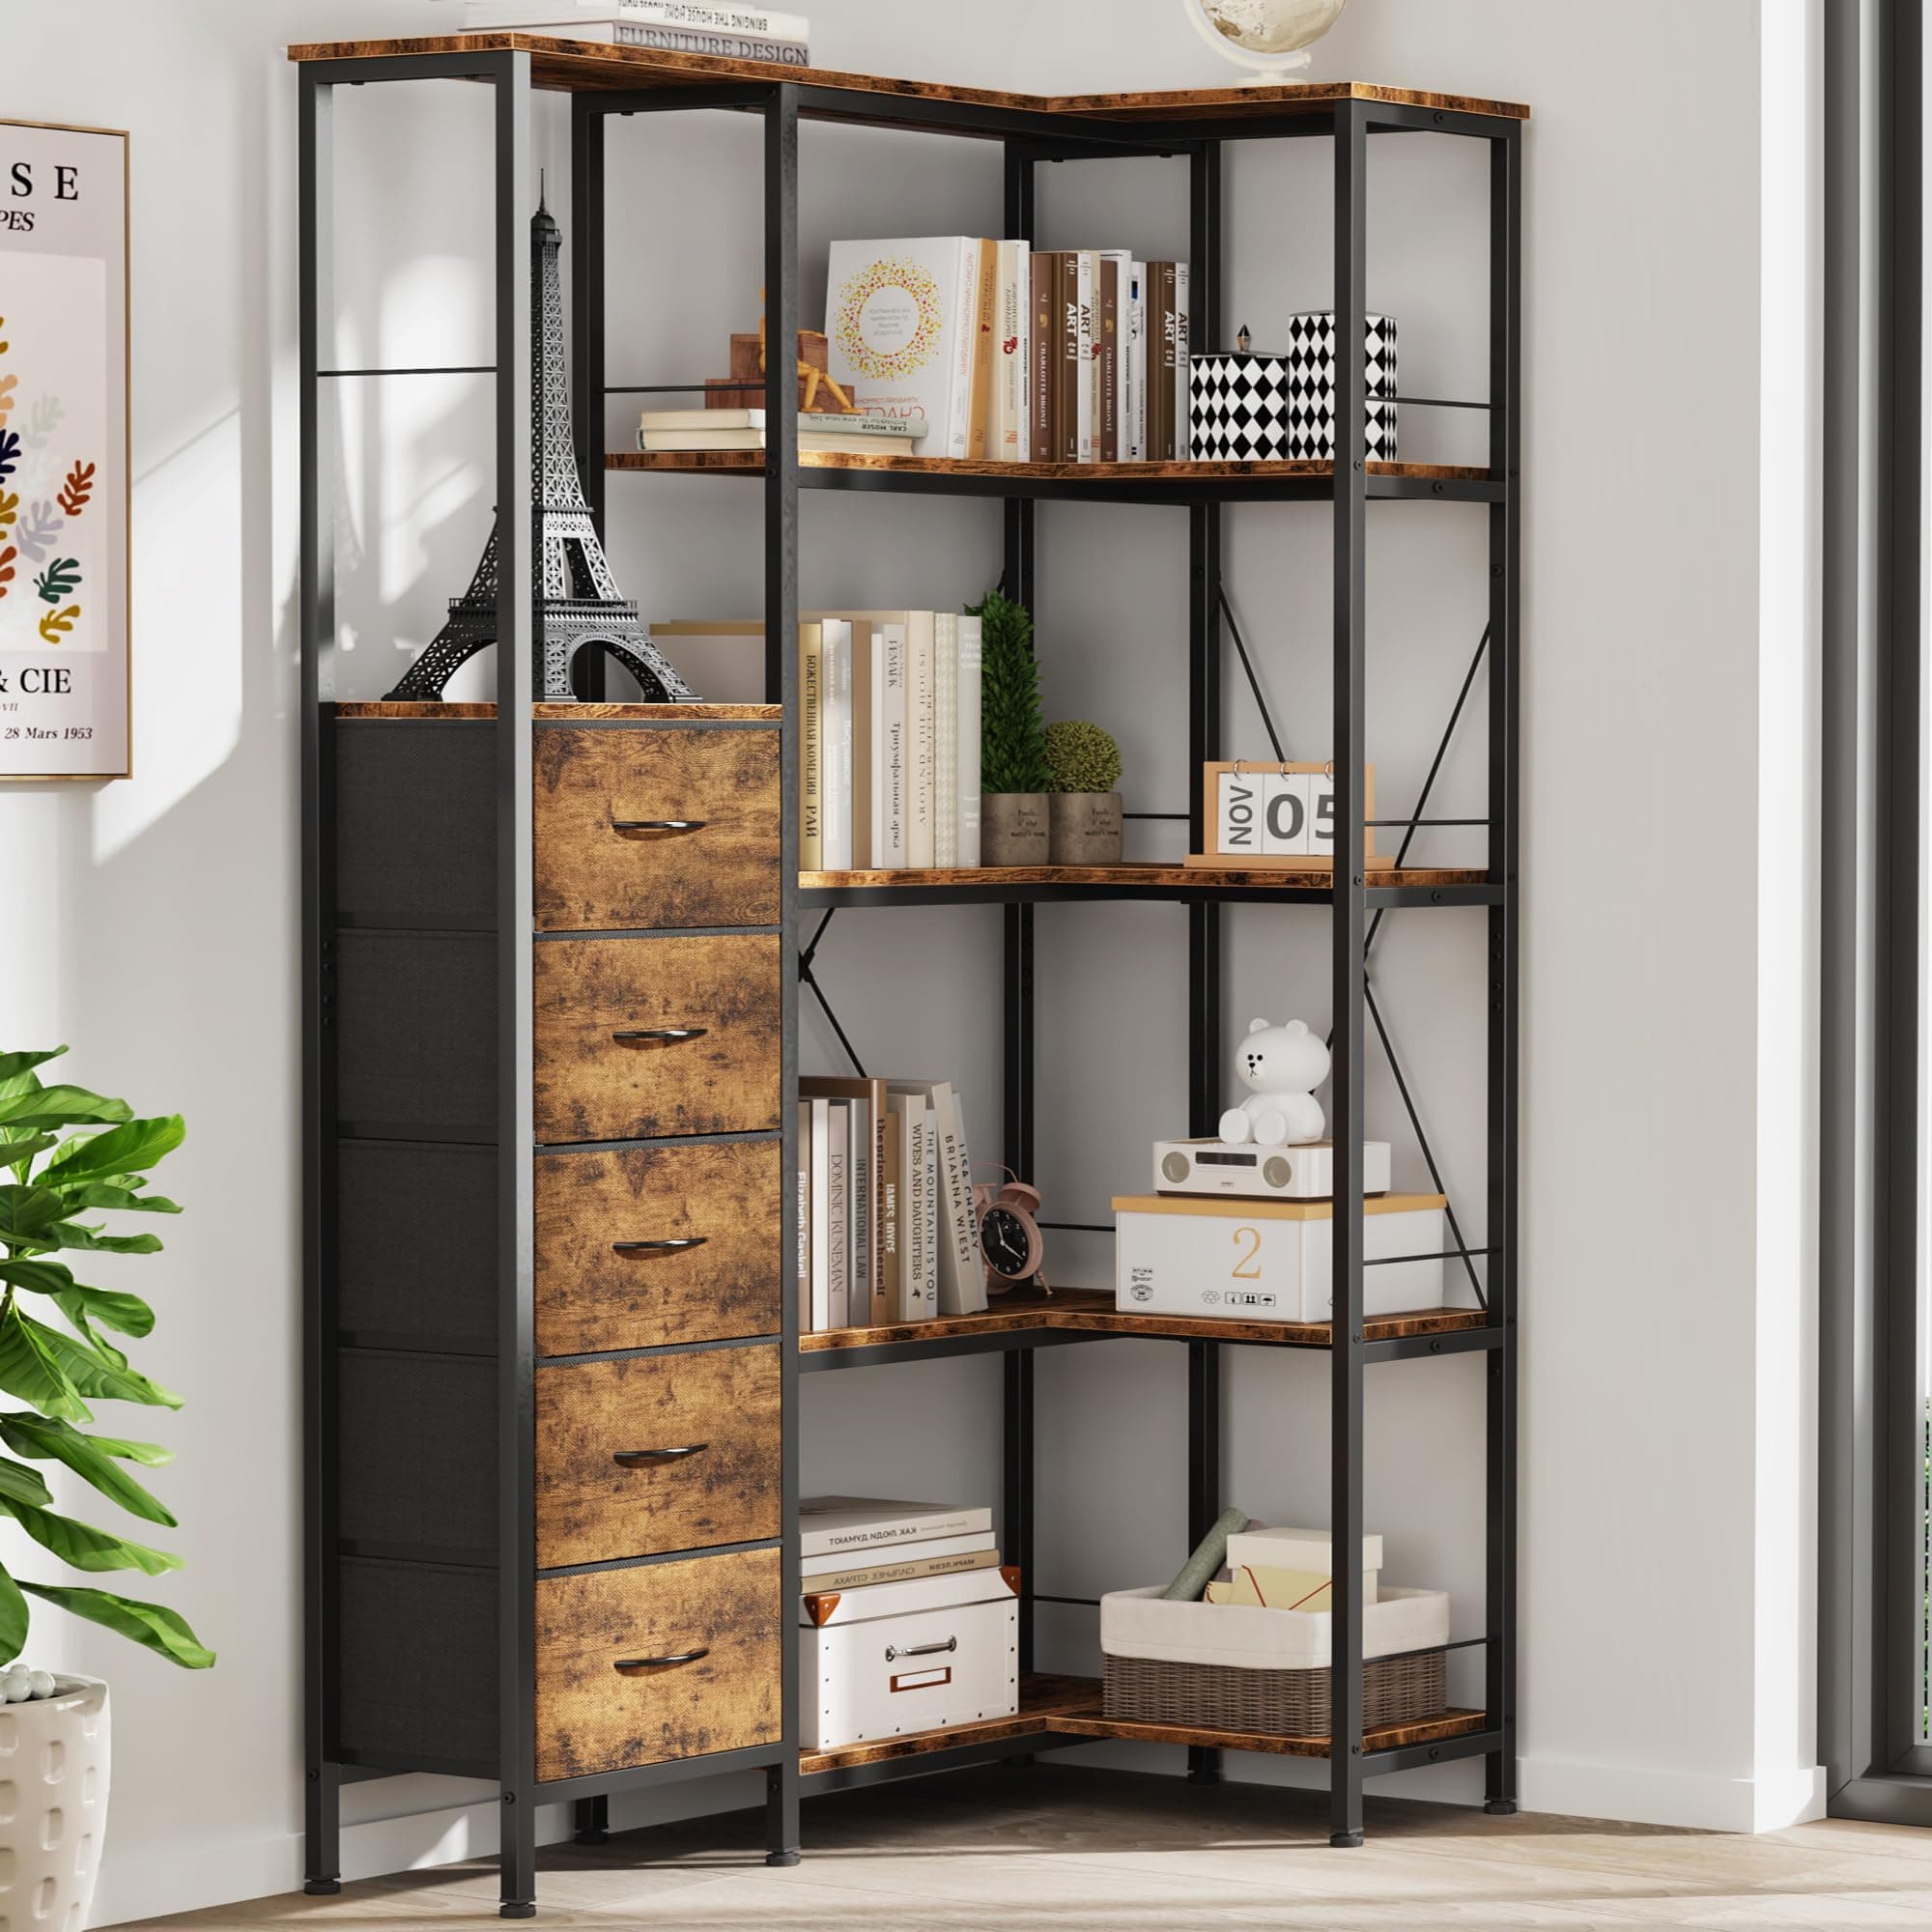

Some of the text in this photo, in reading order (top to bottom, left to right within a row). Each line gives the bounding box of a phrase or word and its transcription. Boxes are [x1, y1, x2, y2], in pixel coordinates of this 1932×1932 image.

[664, 7, 686, 21] HOME
[687, 11, 713, 24] HOUSE
[714, 14, 730, 27] THE
[617, 26, 809, 65] FURNITURE DESIGN
[1066, 302, 1077, 336] ART
[1081, 304, 1091, 337] ART
[1164, 311, 1175, 344] ART
[1178, 312, 1188, 344] ART
[1039, 342, 1048, 393] CHARLOTTE
[1105, 347, 1114, 397] CHARLOTTE
[862, 423, 887, 432] MOSER
[19, 668, 71, 694] CIE
[888, 640, 898, 688] РЕМАРК
[4, 727, 94, 740] 28 Mars 1953
[806, 655, 819, 838] БОЖЕСТВЕННАЯ КОМЕДИЯ РАЙ
[890, 721, 901, 848] Триумфальная арка
[1228, 784, 1253, 845] NOV
[831, 1153, 842, 1292] DOMINIC KUNEMAN
[855, 1158, 866, 1279] INTERNATIONAL LAW
[911, 1123, 923, 1280] WIVES AND DAUGHTERS
[926, 1130, 935, 1301] THE MOUNTAIN IS YOU
[945, 1134, 971, 1264] BRIANNA WIEST
[797, 1171, 807, 1278] Elizabeth Gaskell
[1231, 1227, 1262, 1279] 2
